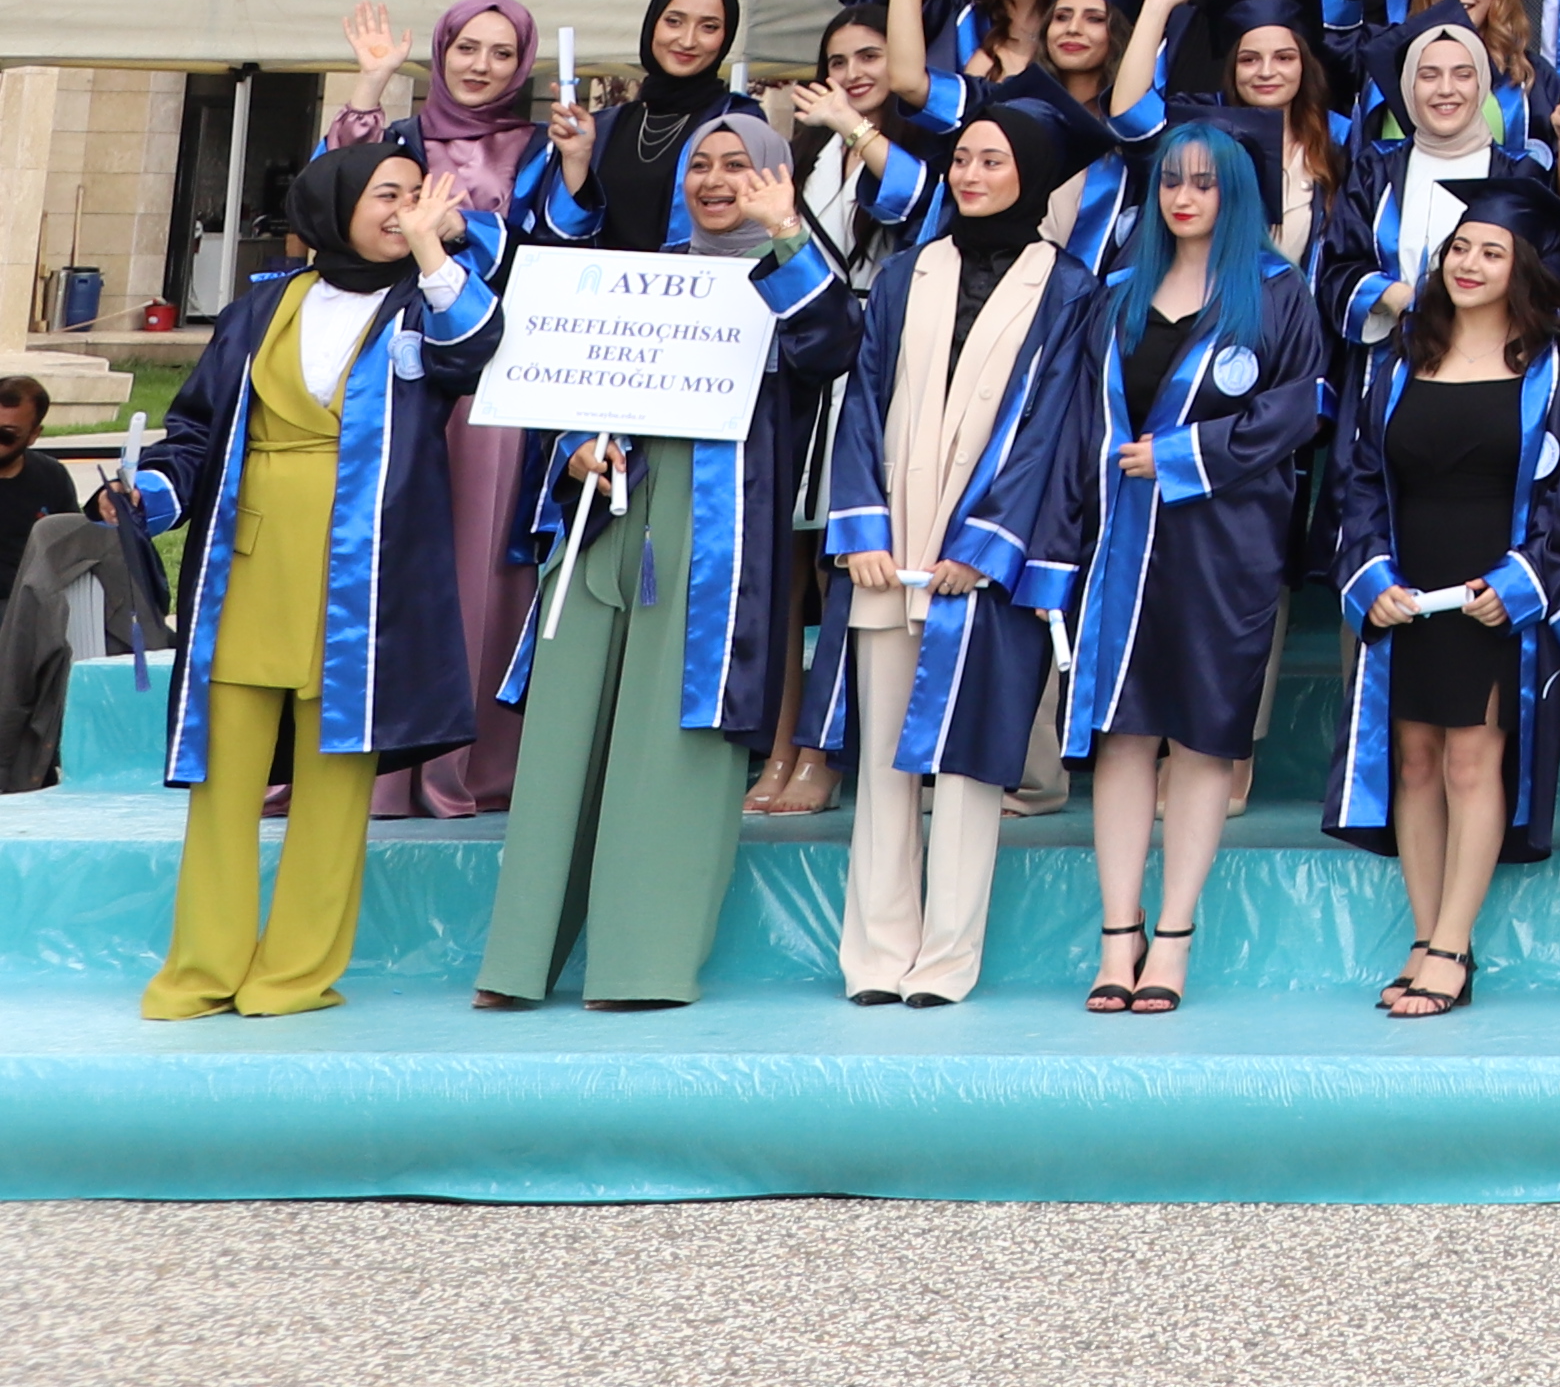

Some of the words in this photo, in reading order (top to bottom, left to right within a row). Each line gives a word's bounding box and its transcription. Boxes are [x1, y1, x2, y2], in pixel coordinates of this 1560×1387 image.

[608, 270, 716, 299] AYBÜ
[525, 315, 742, 344] ŞEREFLİKOÇHİSAR
[587, 344, 662, 365] BERAT
[506, 363, 676, 391] CÖMERTOĞLU
[680, 377, 734, 395] MYO
